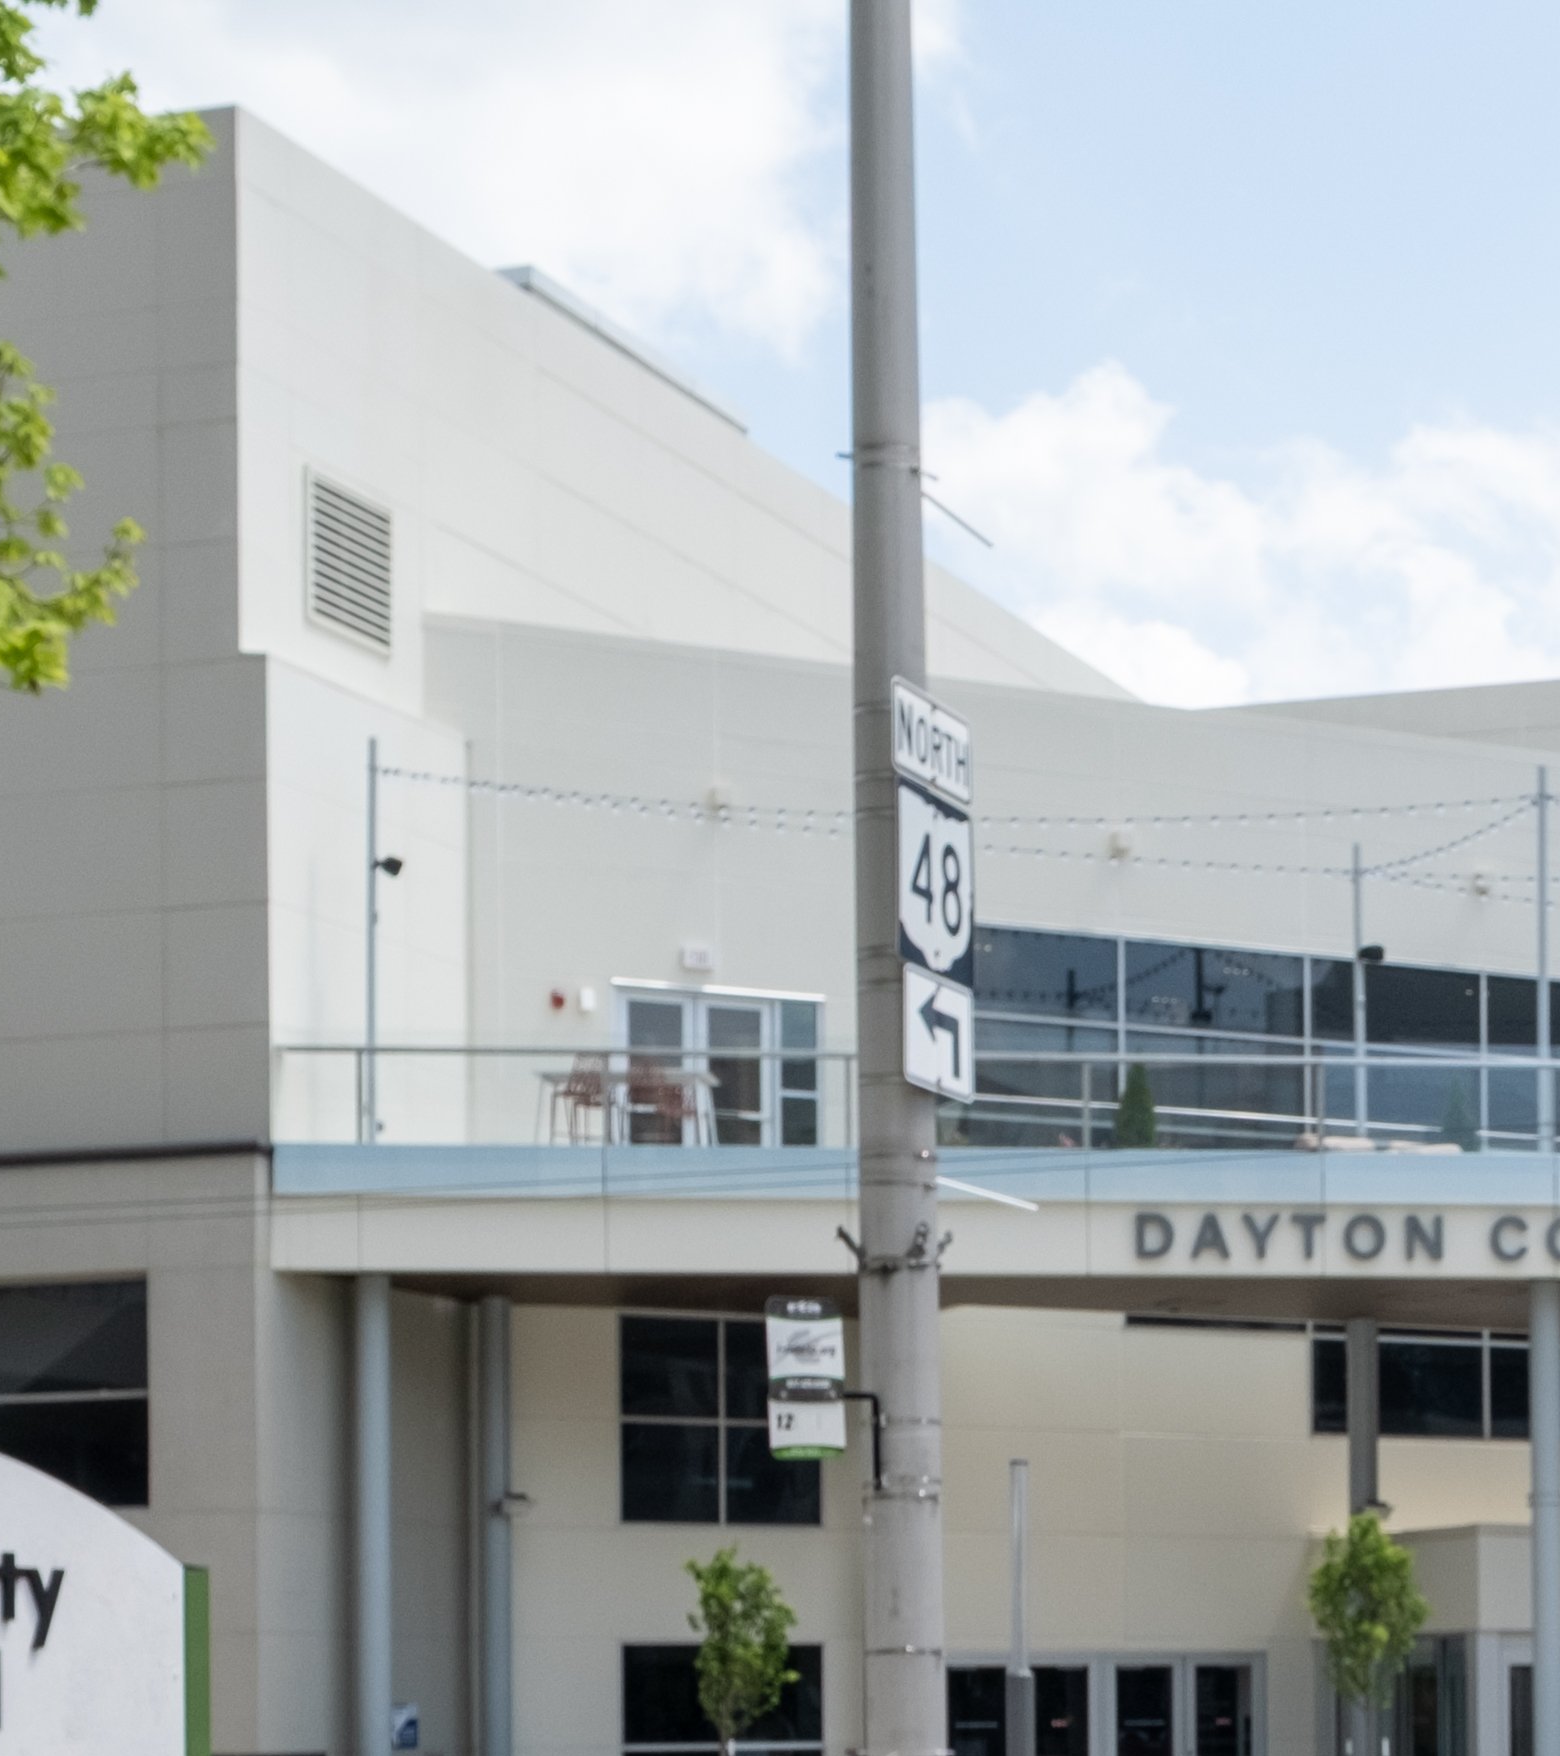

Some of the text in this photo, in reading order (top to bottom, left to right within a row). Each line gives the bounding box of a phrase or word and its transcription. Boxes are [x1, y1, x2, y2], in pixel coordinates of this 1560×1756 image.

[897, 698, 970, 788] NORTH
[910, 832, 962, 937] 48
[1135, 1212, 1444, 1261] DAYTON
[776, 1413, 794, 1431] 12
